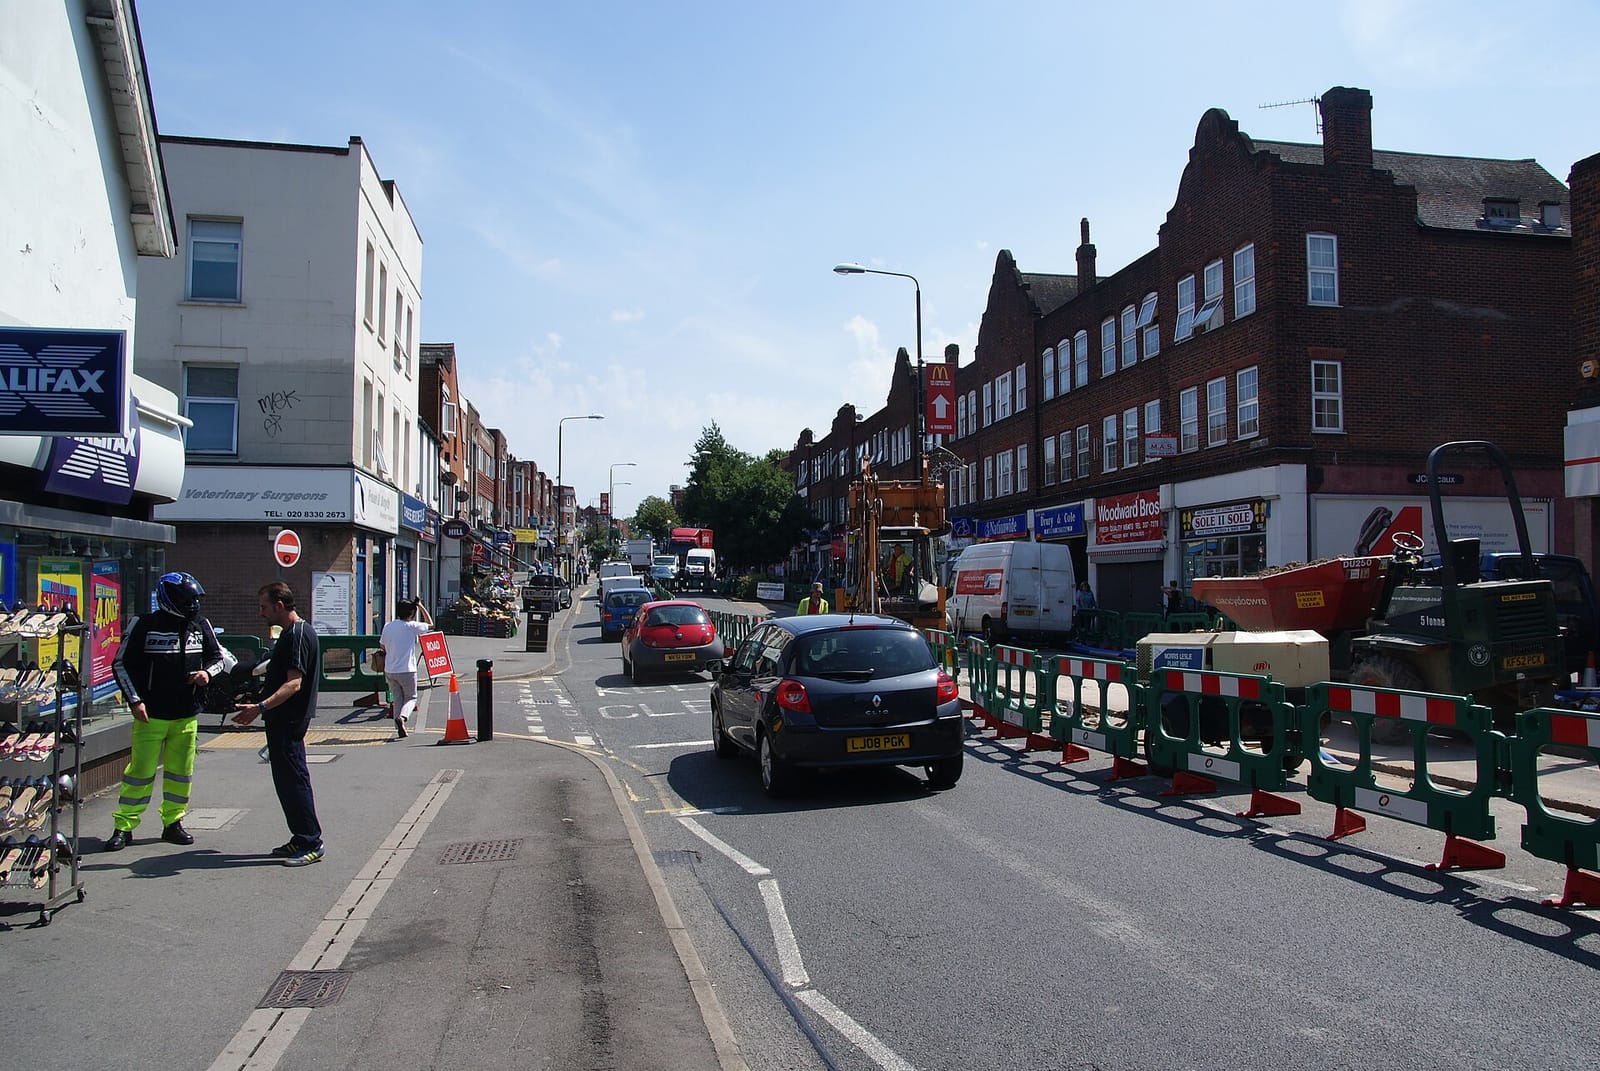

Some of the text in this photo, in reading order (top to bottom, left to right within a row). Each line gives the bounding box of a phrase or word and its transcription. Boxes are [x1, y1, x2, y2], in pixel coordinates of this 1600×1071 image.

[0, 367, 105, 393] LIFAX
[185, 489, 328, 502] Veterinary Surgeons
[264, 510, 283, 518] TEL:
[1098, 498, 1160, 523] Woodward Bros
[1195, 516, 1216, 528] SOLE
[1227, 512, 1250, 525] SOLE
[448, 528, 463, 536] HILL
[1420, 615, 1445, 626] 5 tonne
[426, 640, 441, 652] ROAD
[428, 656, 448, 668] CLOSED
[851, 735, 905, 750] LJ08 PGK
